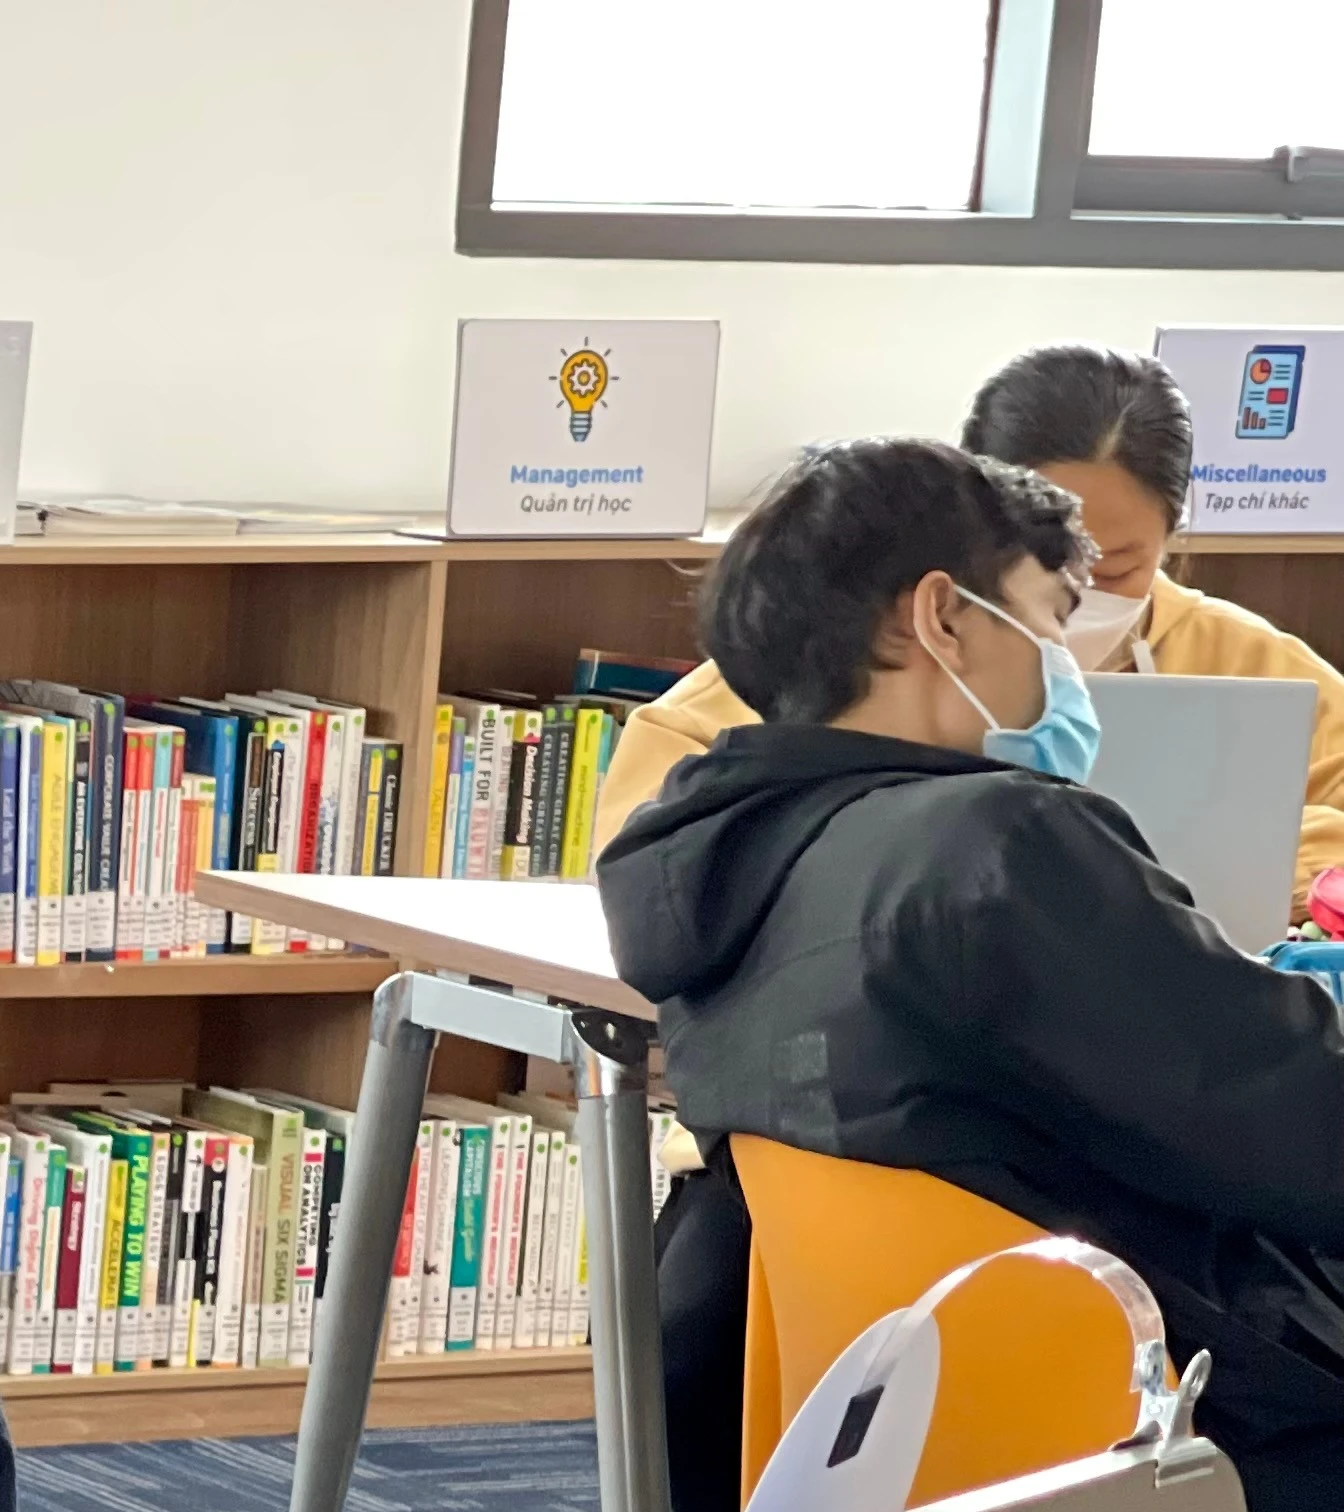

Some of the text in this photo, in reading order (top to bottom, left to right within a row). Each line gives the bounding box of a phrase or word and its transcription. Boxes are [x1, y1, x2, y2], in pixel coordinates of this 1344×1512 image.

[510, 464, 644, 488] Management
[519, 492, 632, 516] Quản trị học
[1191, 464, 1327, 484] Miscellaneous
[1267, 490, 1311, 510] khác
[102, 755, 115, 819] CORPORATE
[476, 718, 496, 801] BUILT FOR
[516, 745, 538, 844] Decision Making
[48, 819, 62, 896] ENGAGEME
[154, 1155, 165, 1191] EDGE
[308, 1164, 323, 1247] COMPETING
[124, 1155, 150, 1298] PLAYING TO WIN
[272, 1153, 295, 1304] VISUAL SIX SIGMA
[296, 1164, 313, 1266] ON ANALYTICS
